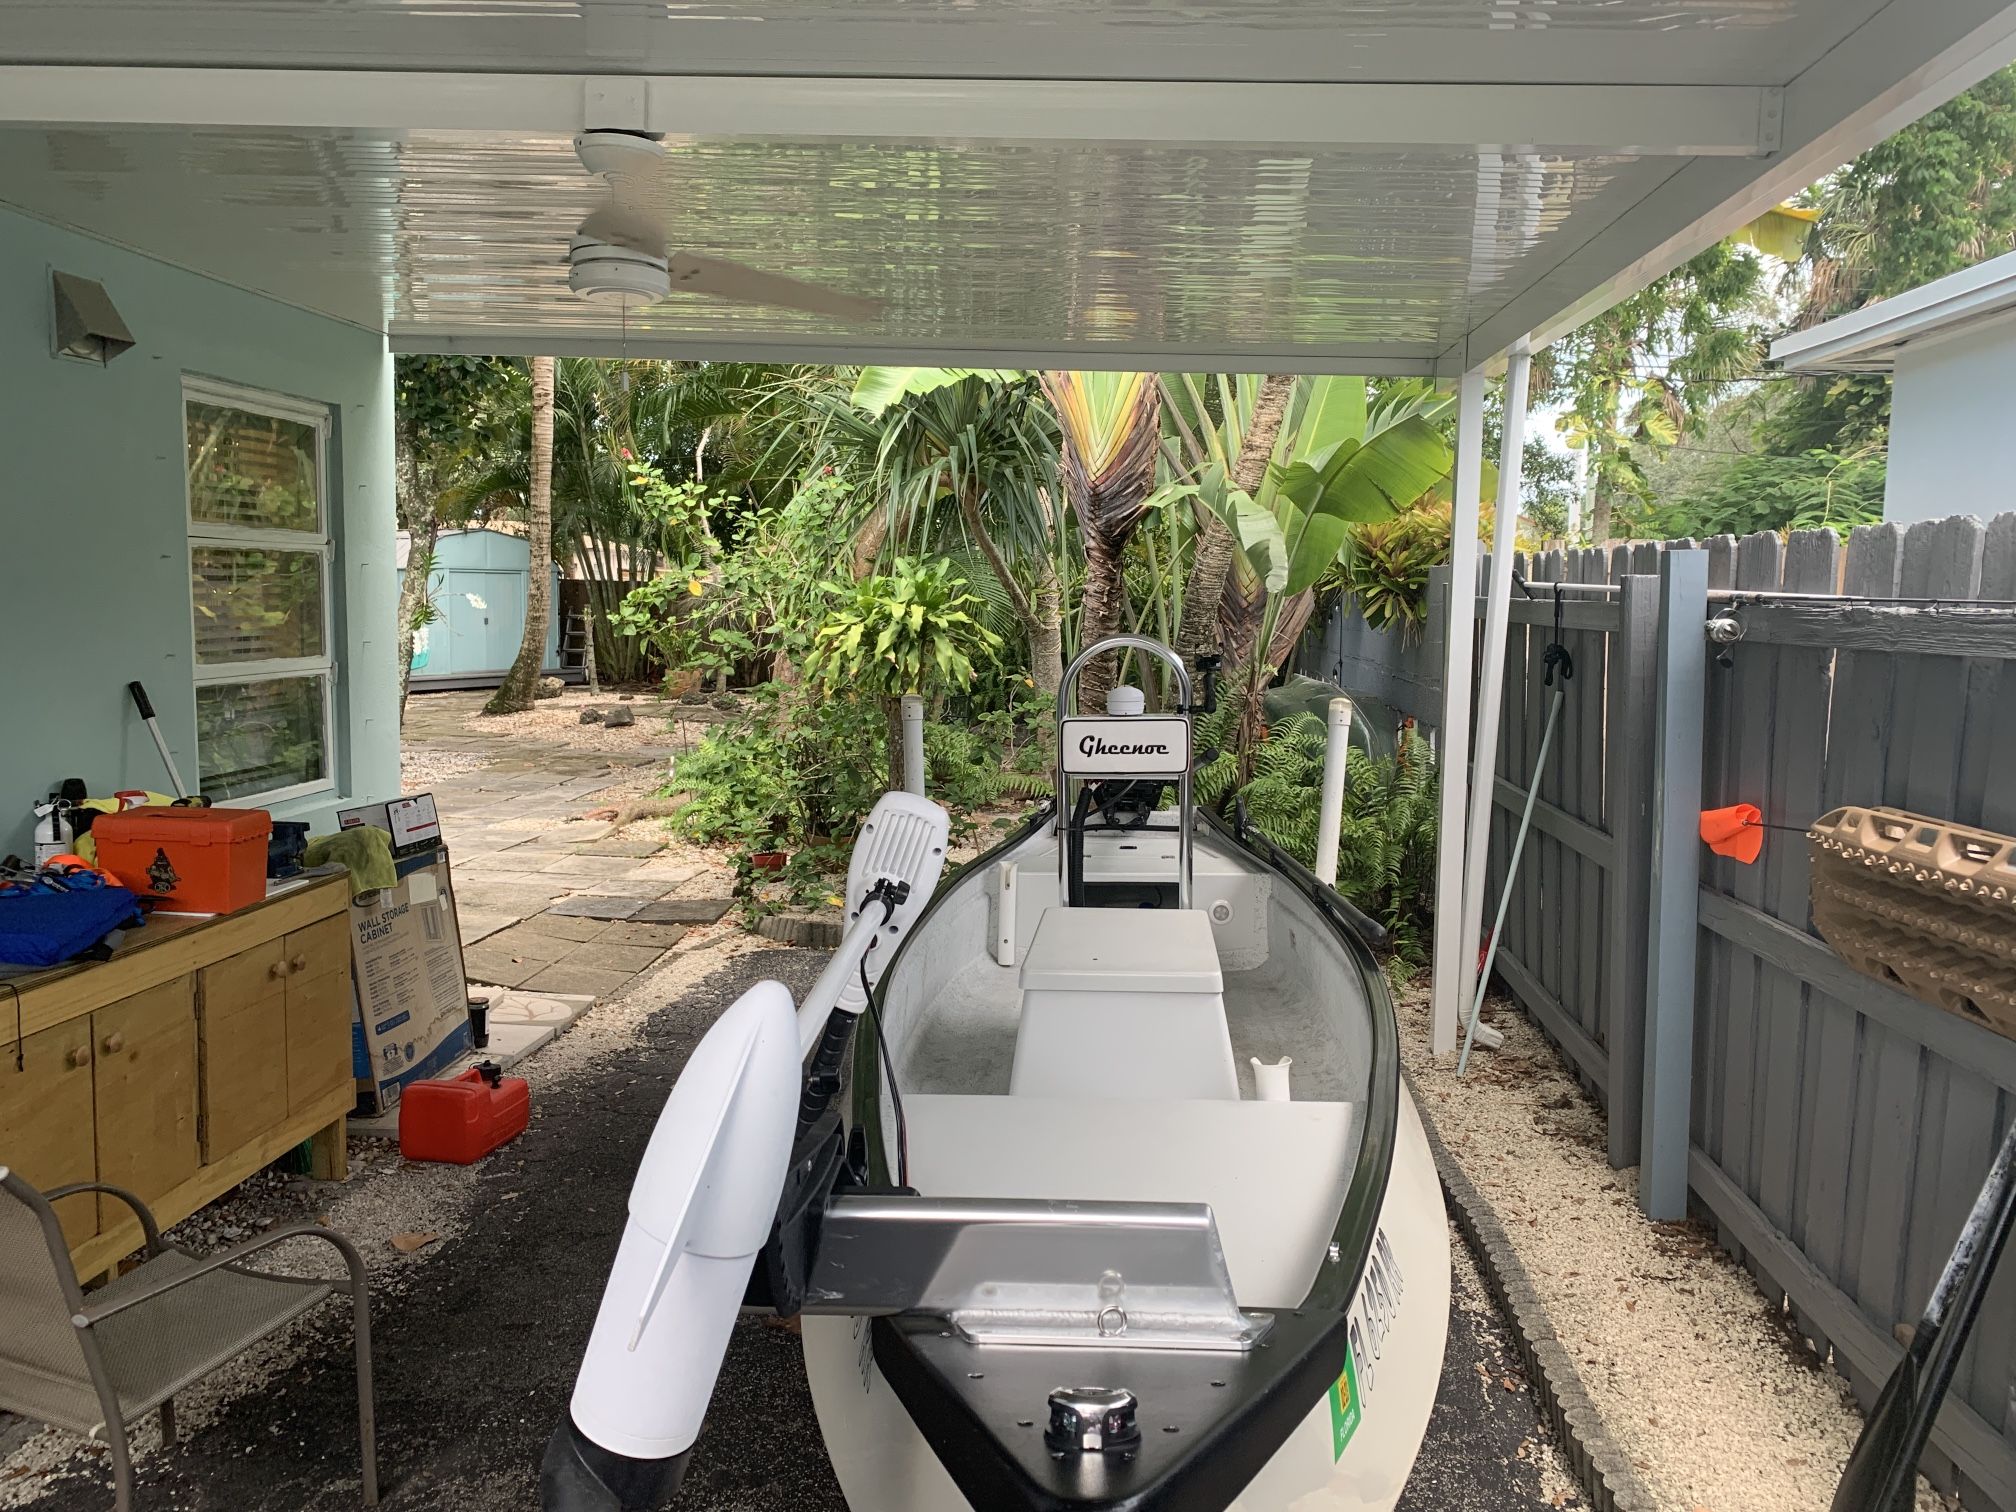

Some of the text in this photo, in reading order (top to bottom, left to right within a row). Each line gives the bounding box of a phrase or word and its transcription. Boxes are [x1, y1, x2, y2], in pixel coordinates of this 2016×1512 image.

[1079, 735, 1170, 757] Gheenoe
[357, 902, 410, 932] WALL STORAGE
[360, 922, 393, 944] CABINET
[1349, 1316, 1374, 1408] FL
[1339, 1408, 1356, 1443] FLORIDA
